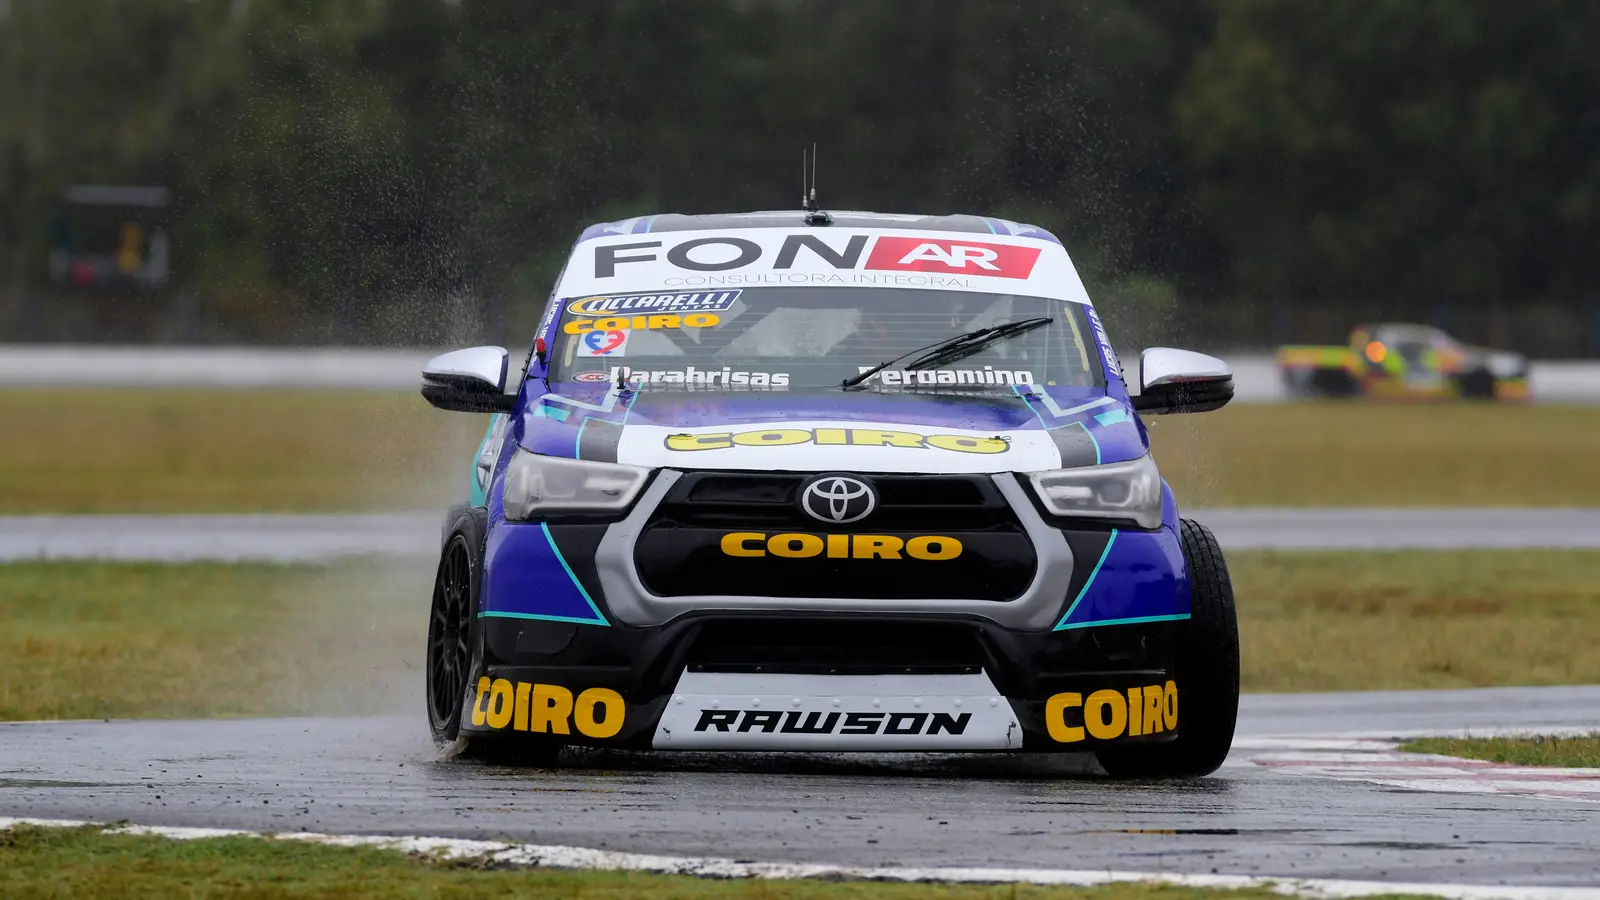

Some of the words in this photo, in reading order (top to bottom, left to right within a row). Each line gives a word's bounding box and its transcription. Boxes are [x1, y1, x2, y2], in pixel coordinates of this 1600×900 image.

[594, 234, 869, 279] FON
[898, 243, 1001, 271] AR
[664, 273, 846, 286] CONSULTORA
[853, 273, 977, 288] INTEGRAL
[586, 292, 730, 311] CICCARELLI
[563, 313, 720, 335] COIRO
[664, 427, 1009, 454] COIRO
[720, 532, 963, 561] COIRO
[471, 676, 626, 739] COIRO
[1045, 680, 1179, 744] COIRO
[693, 709, 973, 736] RAWSON
